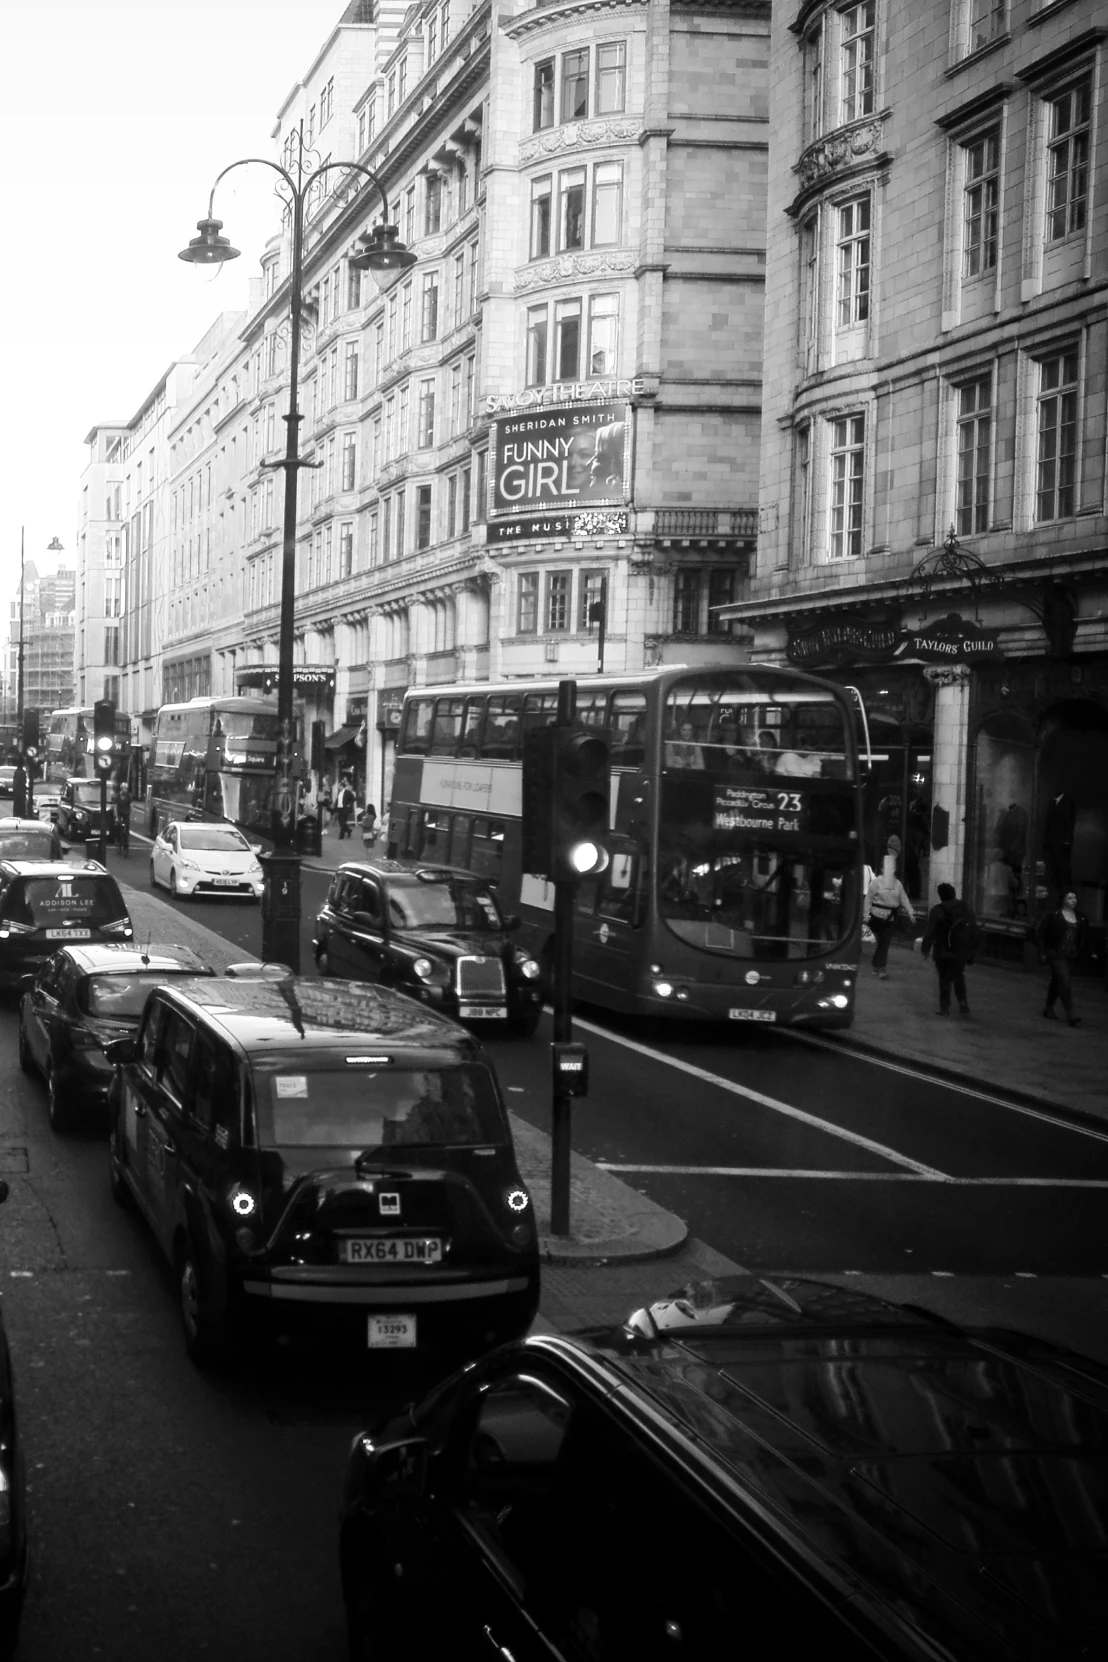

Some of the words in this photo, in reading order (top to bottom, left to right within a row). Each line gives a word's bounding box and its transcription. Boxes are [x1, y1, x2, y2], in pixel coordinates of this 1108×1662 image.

[486, 388, 544, 413] SAVOY
[548, 379, 644, 401] THEATRE
[505, 418, 566, 434] SHERIDAN
[573, 413, 615, 425] SMITH
[503, 436, 574, 464] FUNNY
[499, 460, 580, 500] GIRL
[499, 525, 522, 536] THE
[963, 640, 994, 652] GUILD
[274, 674, 326, 682] SPSON'S
[726, 789, 766, 801] Paddington
[752, 800, 775, 809] Circus
[777, 792, 802, 811] 23
[715, 812, 774, 829] Westbourne
[777, 817, 800, 831] Park
[52, 929, 71, 937] LK64
[560, 1062, 583, 1071] WAIT
[351, 1241, 399, 1260] RX64
[403, 1240, 439, 1260] DWP
[378, 1324, 408, 1335] 13293
